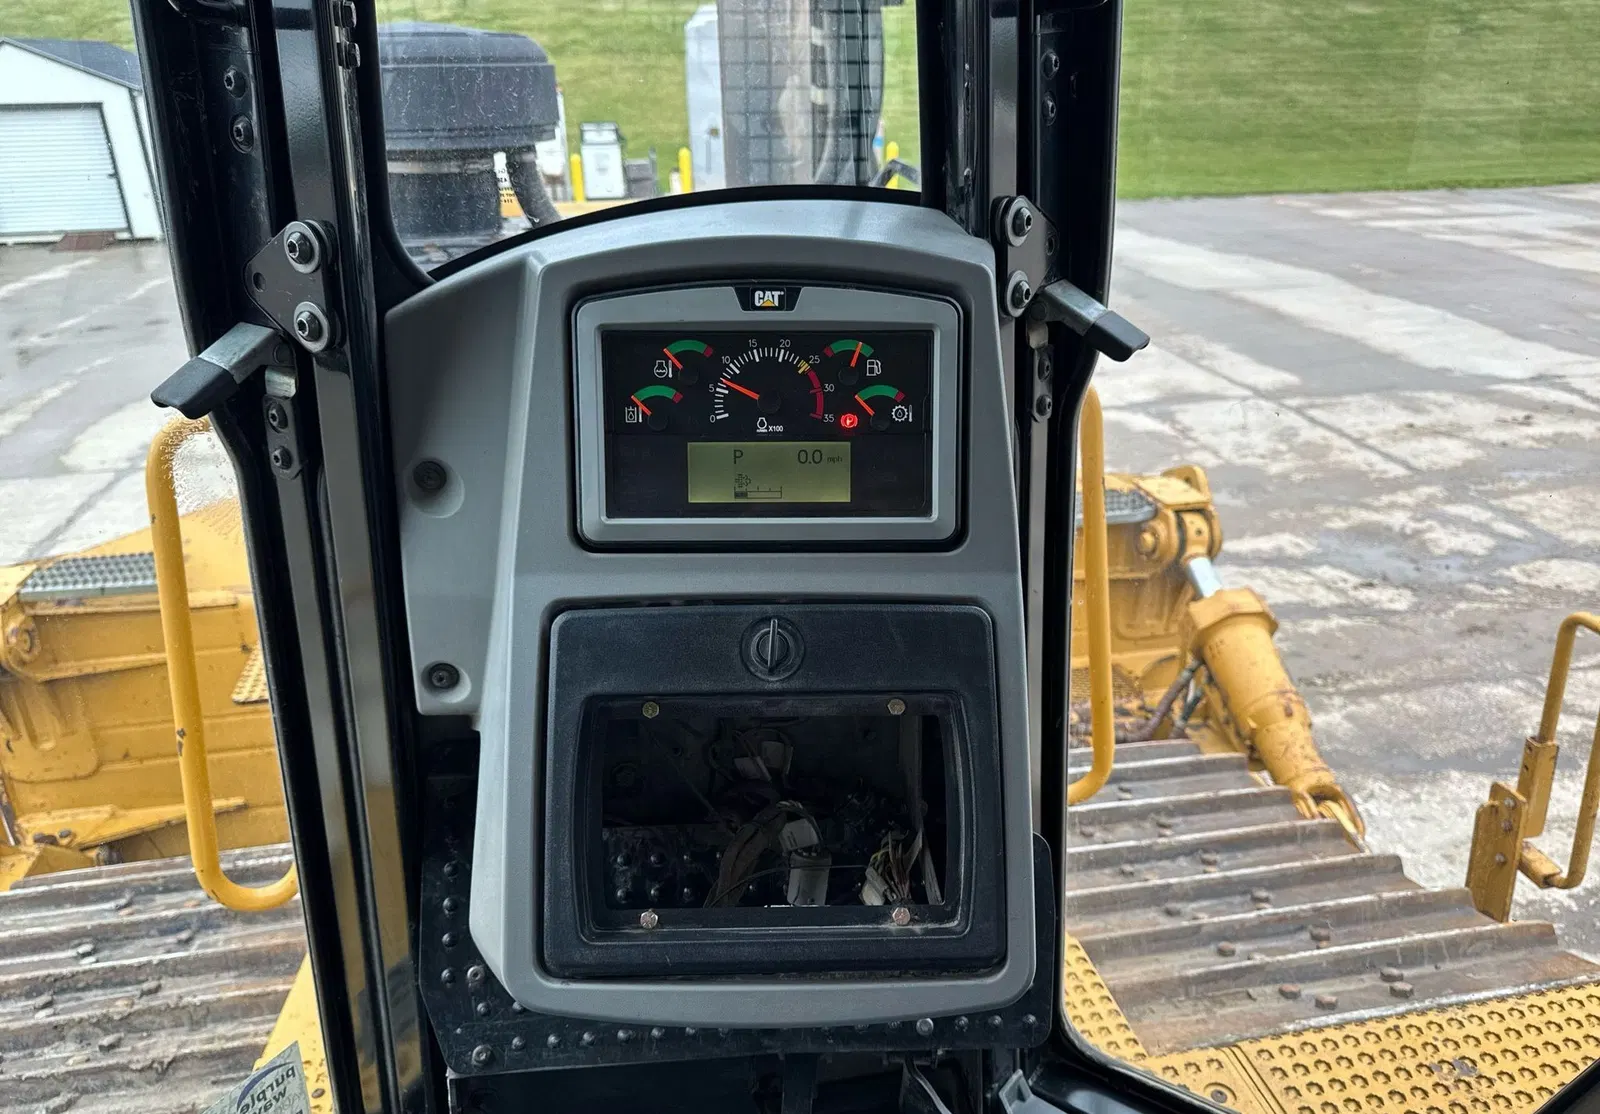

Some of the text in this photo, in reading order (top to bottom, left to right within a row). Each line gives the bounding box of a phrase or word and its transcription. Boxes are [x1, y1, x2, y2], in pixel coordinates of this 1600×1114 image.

[754, 290, 781, 307] CAT
[748, 339, 758, 348] 15
[779, 339, 791, 348] 20
[721, 356, 731, 364] 10
[808, 355, 820, 364] 25
[708, 384, 715, 393] 5
[823, 384, 835, 392] 30
[709, 415, 716, 423] 0
[823, 414, 835, 423] 35
[733, 449, 744, 465] P
[797, 449, 843, 464] 0.0 mph
